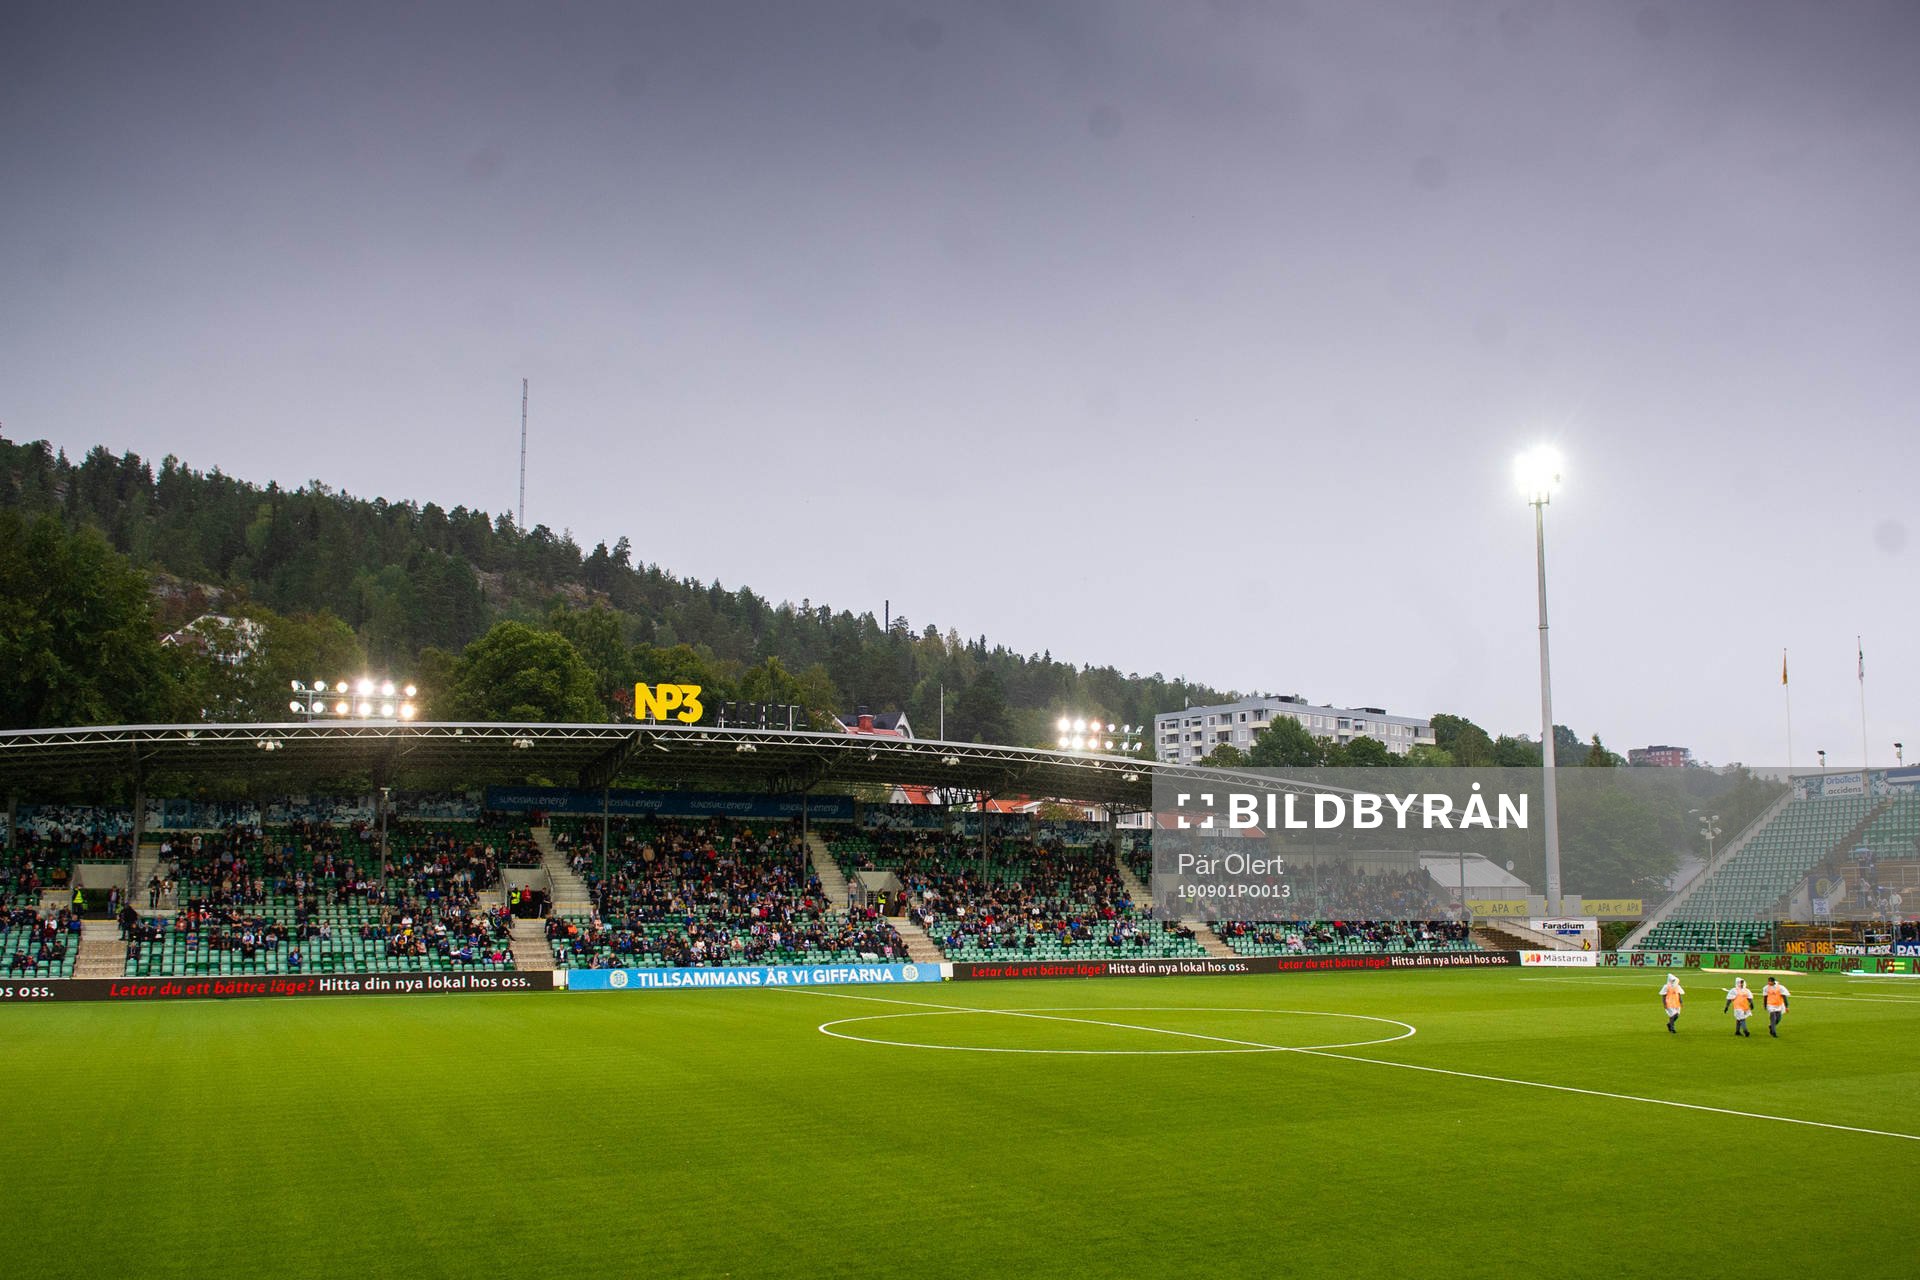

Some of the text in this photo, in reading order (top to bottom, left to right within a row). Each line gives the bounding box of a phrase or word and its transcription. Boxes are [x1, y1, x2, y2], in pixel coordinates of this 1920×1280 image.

[634, 682, 703, 723] NP3
[1492, 903, 1509, 913] APA
[1543, 922, 1585, 930] Faradium
[1391, 956, 1414, 966] Hitta
[1416, 955, 1430, 965] din
[1433, 958, 1448, 967] nya
[1451, 955, 1472, 965] lokal
[1475, 955, 1488, 964] hos
[1544, 953, 1588, 962] Mästarna
[1604, 954, 1619, 967] NP3
[1630, 954, 1645, 967] NP3
[1657, 954, 1672, 967] NP3
[1685, 954, 1701, 967] NP3
[1714, 955, 1730, 969] NP3
[972, 961, 1249, 977] Letar du ett bättre läge? Hitta din nya lokal hos oss.
[637, 971, 760, 987] TILLSAMMANS
[765, 968, 788, 984] ÄR
[793, 970, 808, 983] VI
[813, 968, 894, 983] GIFFARNA
[19, 986, 54, 997] oss.
[109, 976, 531, 996] Letar du ett bättre läge? Hitta din nya lokal hos oss.
